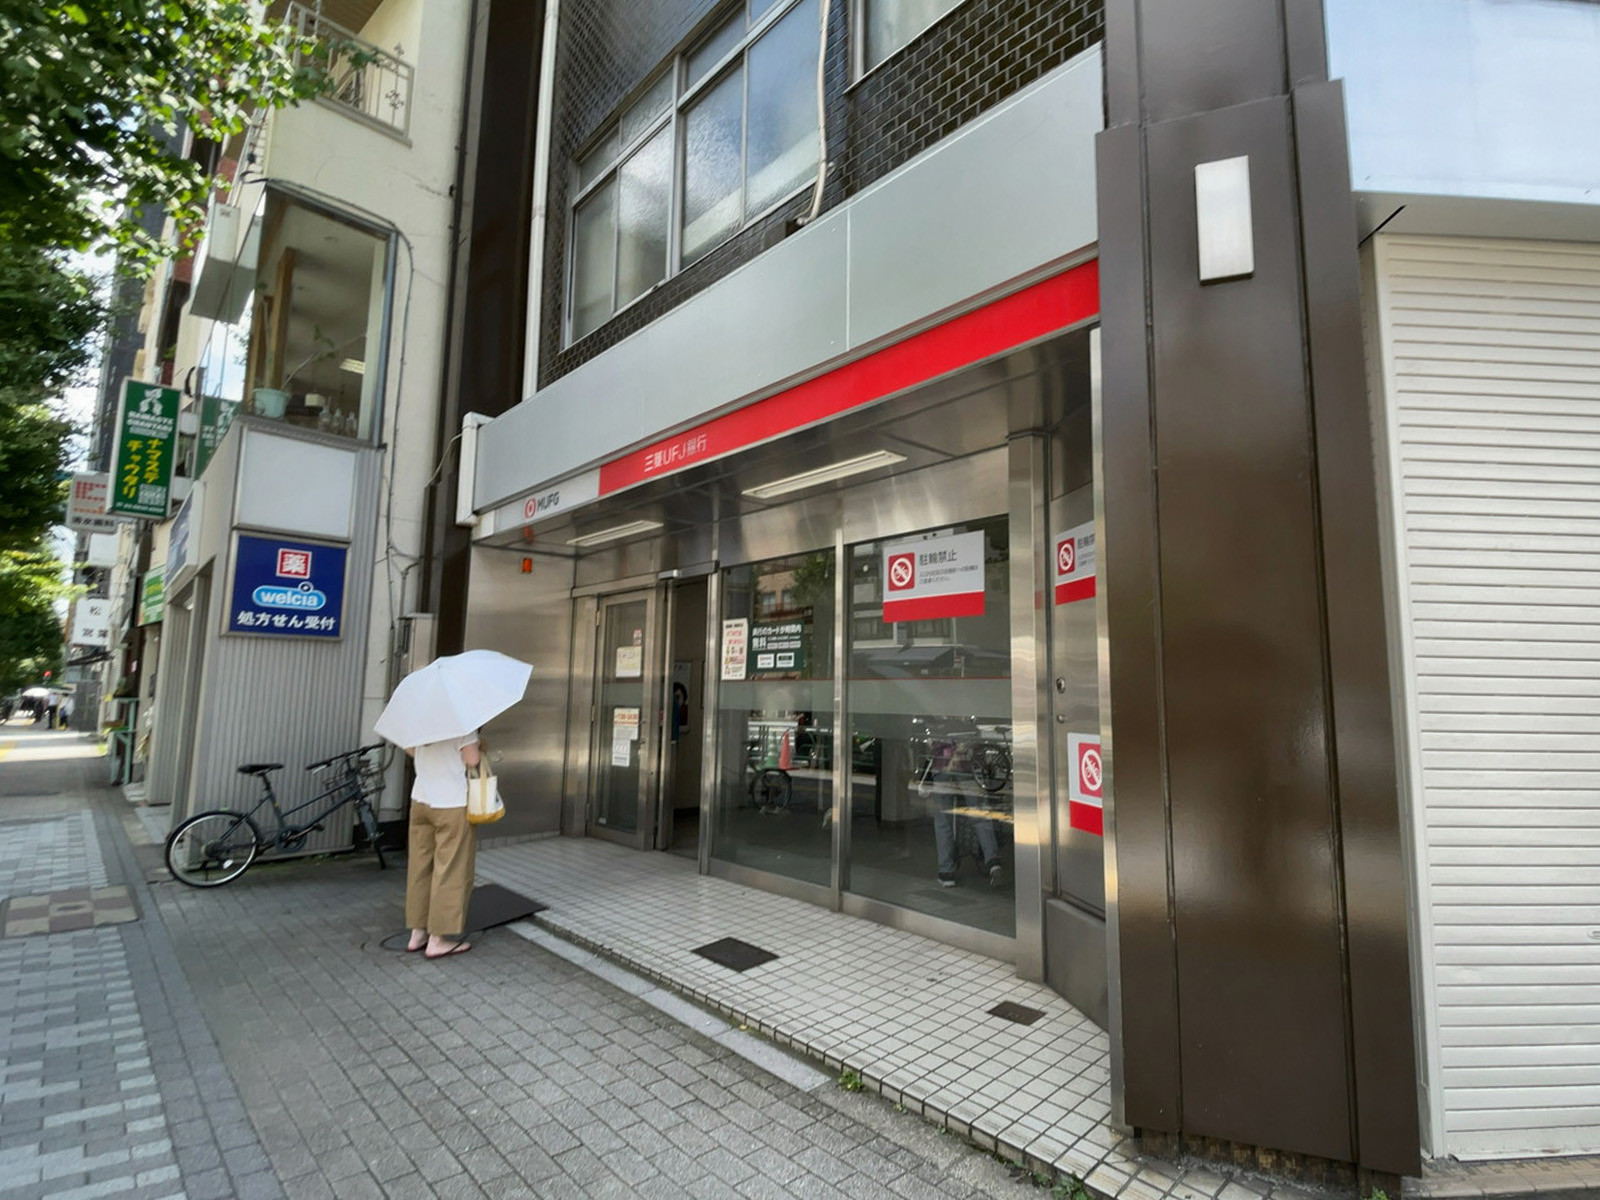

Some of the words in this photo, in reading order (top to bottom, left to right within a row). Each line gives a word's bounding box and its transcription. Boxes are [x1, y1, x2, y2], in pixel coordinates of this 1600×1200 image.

[143, 437, 164, 485] ナマステ
[643, 433, 707, 473] 三菱UFJ銀行
[122, 438, 144, 499] チャウタリ
[537, 491, 560, 512] MUFG
[282, 553, 307, 575] 薬
[919, 548, 958, 567] 駐輪禁止
[260, 590, 318, 607] welcia
[237, 610, 336, 631] 処方せん受付
